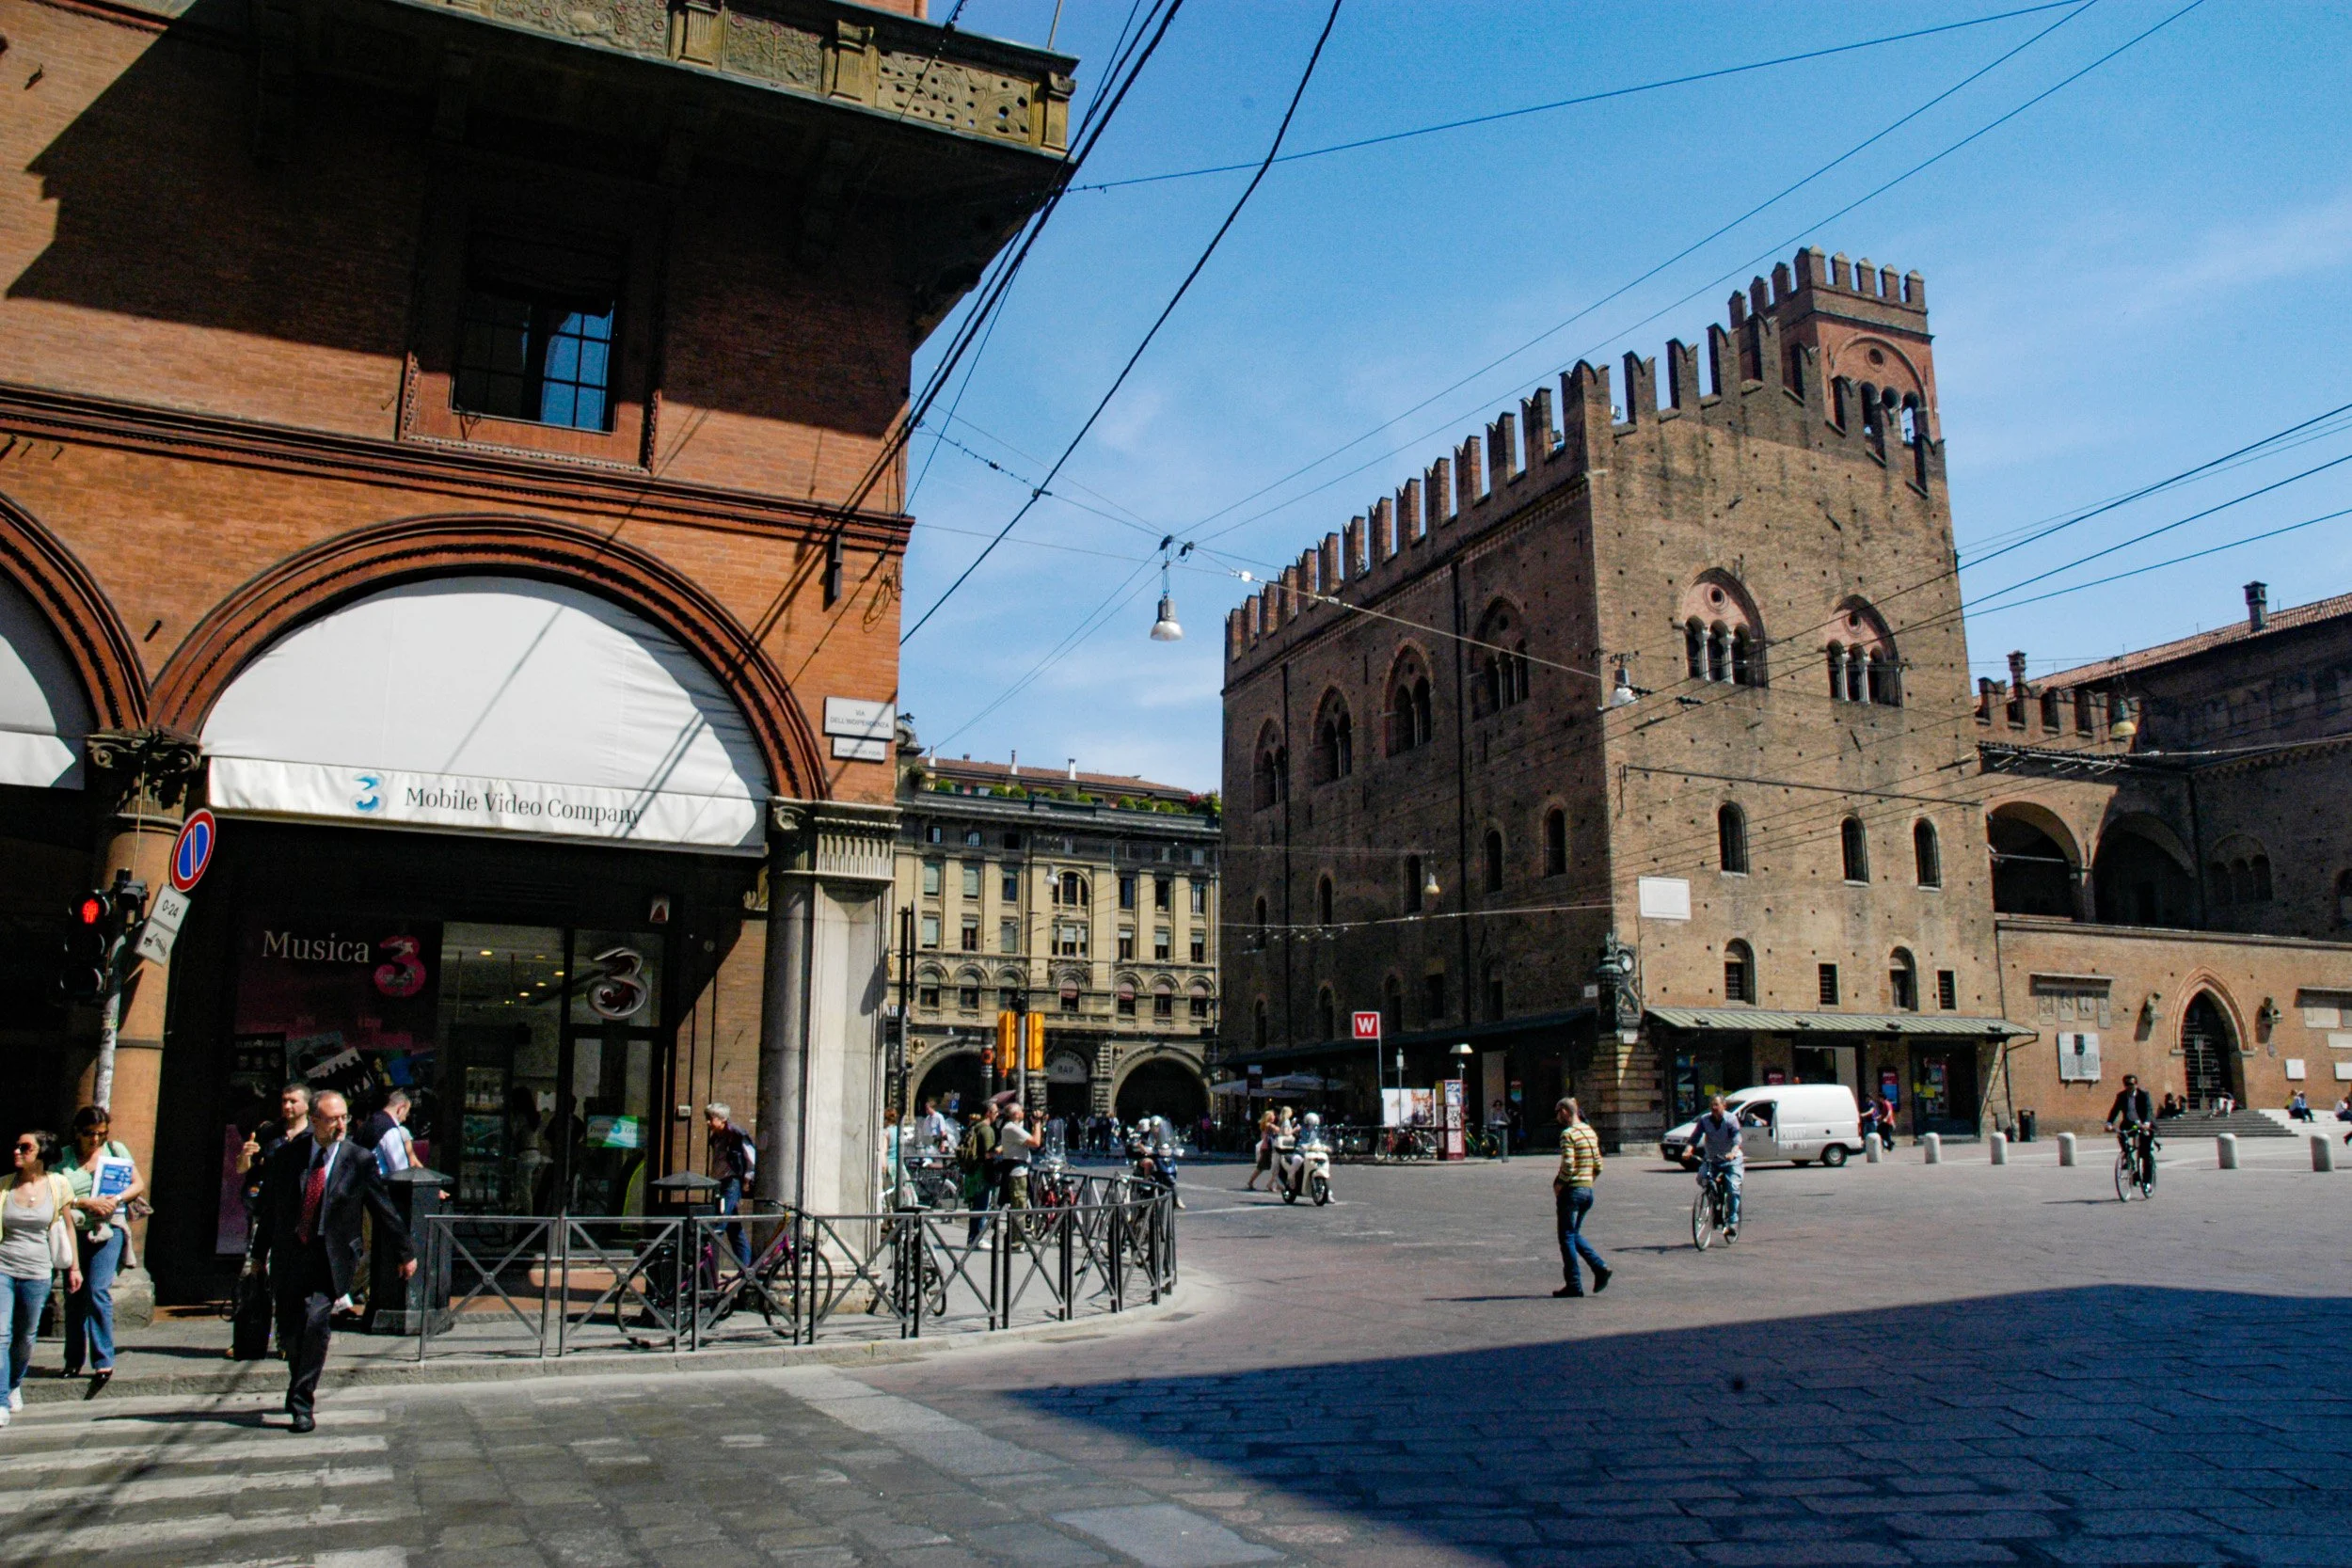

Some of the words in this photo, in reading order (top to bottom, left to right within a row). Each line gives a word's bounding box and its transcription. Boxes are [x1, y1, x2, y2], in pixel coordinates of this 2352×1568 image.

[405, 786, 478, 813] Mobile
[484, 792, 542, 817] Video
[548, 799, 645, 830] Company
[162, 899, 180, 919] 0-24
[261, 930, 371, 963] Musica
[1357, 1017, 1375, 1034] W
